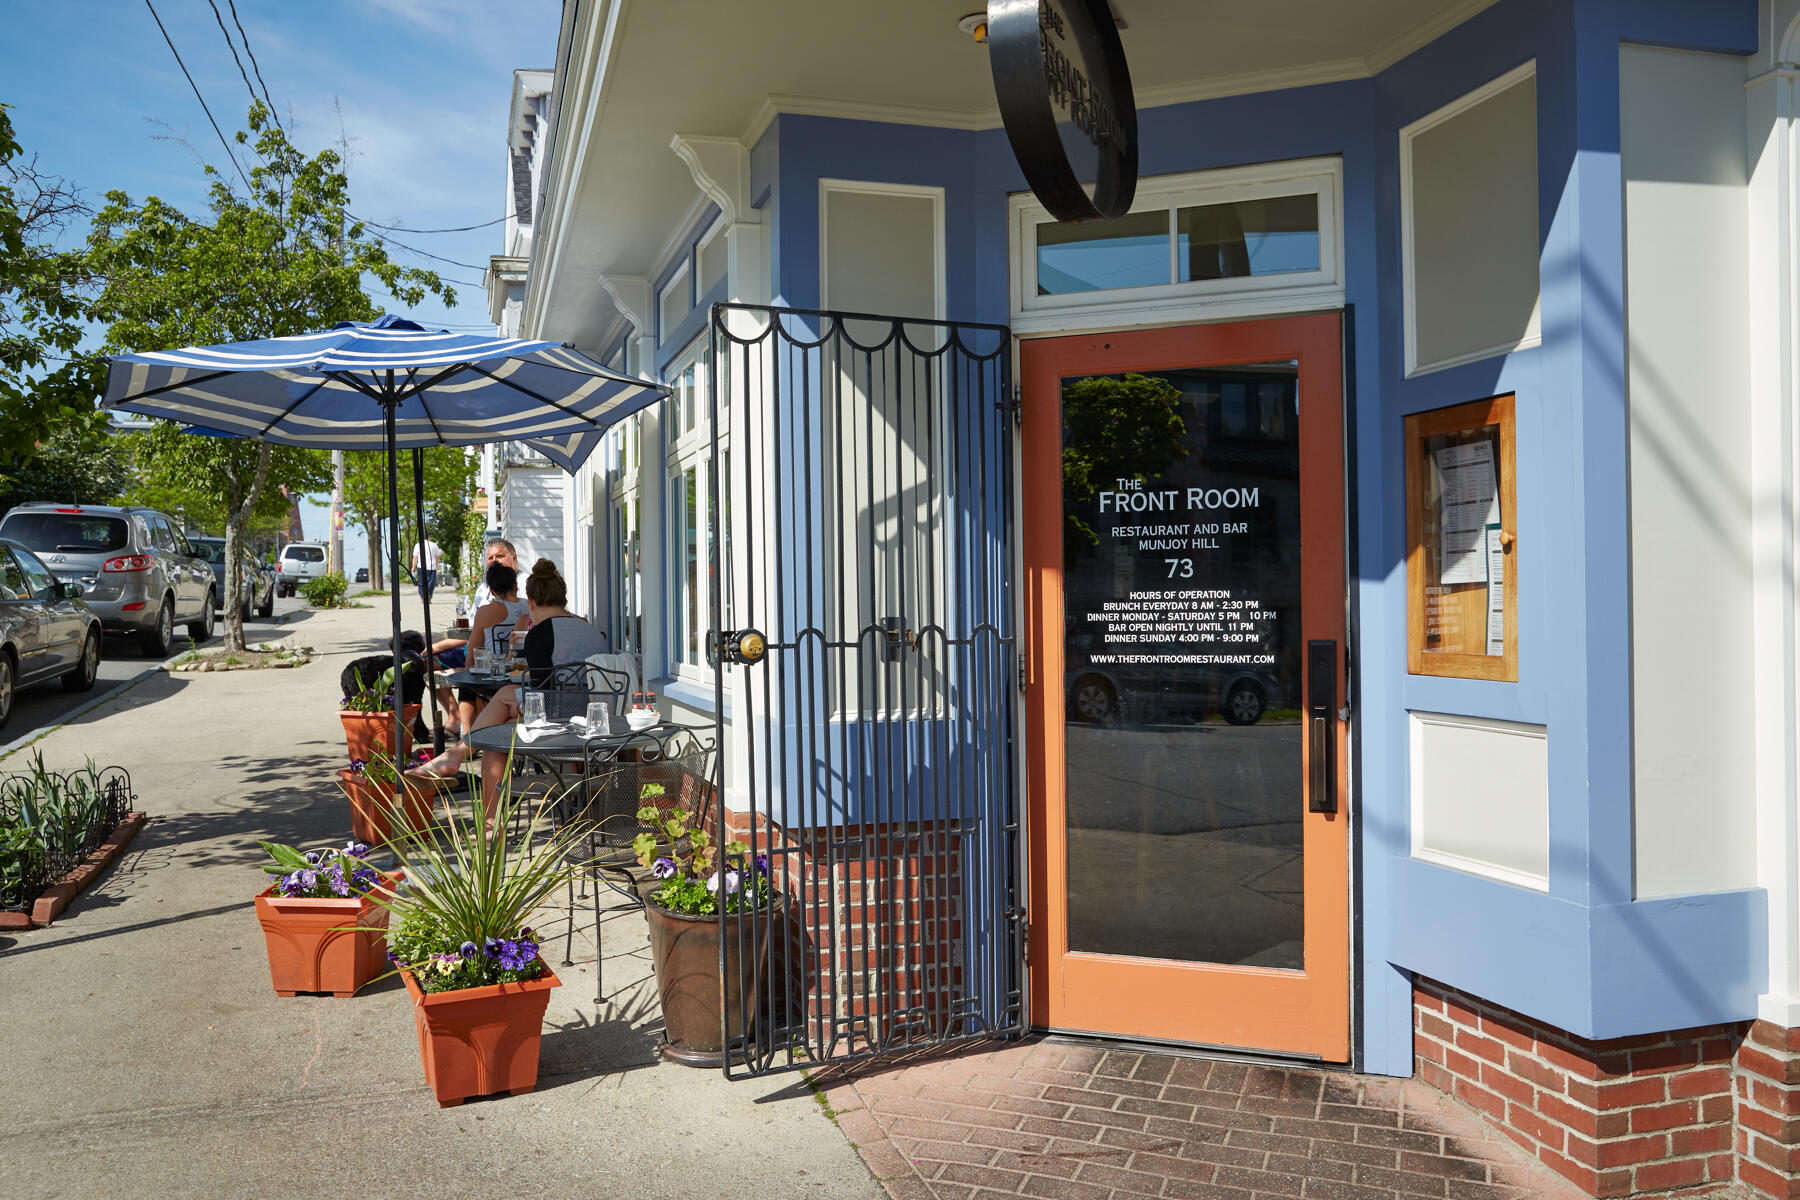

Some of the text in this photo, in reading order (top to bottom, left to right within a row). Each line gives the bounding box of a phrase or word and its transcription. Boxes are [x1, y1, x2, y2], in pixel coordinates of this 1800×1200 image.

[1116, 478, 1143, 491] THE
[1099, 487, 1259, 513] FRONT ROOM
[1111, 522, 1248, 537] RESTAURANT AND BAR
[1139, 537, 1220, 551] MUNJOY HILL
[1164, 558, 1194, 578] 73
[1129, 589, 1231, 600] HOURS OF OPERATION
[1103, 602, 1141, 611] BRUNCH
[1142, 601, 1190, 611] EVERYDAY
[1191, 601, 1199, 610] 8
[1199, 601, 1214, 610] AM
[1221, 600, 1244, 610] 2:30
[1244, 600, 1259, 610] PM
[1087, 612, 1120, 622] DINNER
[1121, 612, 1160, 622] MONDAY
[1167, 612, 1216, 622] SATURDAY
[1218, 612, 1225, 621] 5
[1226, 611, 1241, 621] PM
[1249, 611, 1261, 620] 10
[1262, 611, 1277, 620] PM
[1108, 622, 1254, 632] BAR OPEN NIGHTLY UNTIL 11 PM
[1104, 634, 1138, 643] DINNER
[1139, 633, 1177, 643] SUNDAY
[1178, 633, 1200, 643] 4:00
[1201, 633, 1215, 642] PM
[1222, 633, 1244, 643] 9:00
[1245, 633, 1259, 643] PM
[1089, 654, 1275, 664] WWW.THEFRONTROOMRESTAURANT.COM
